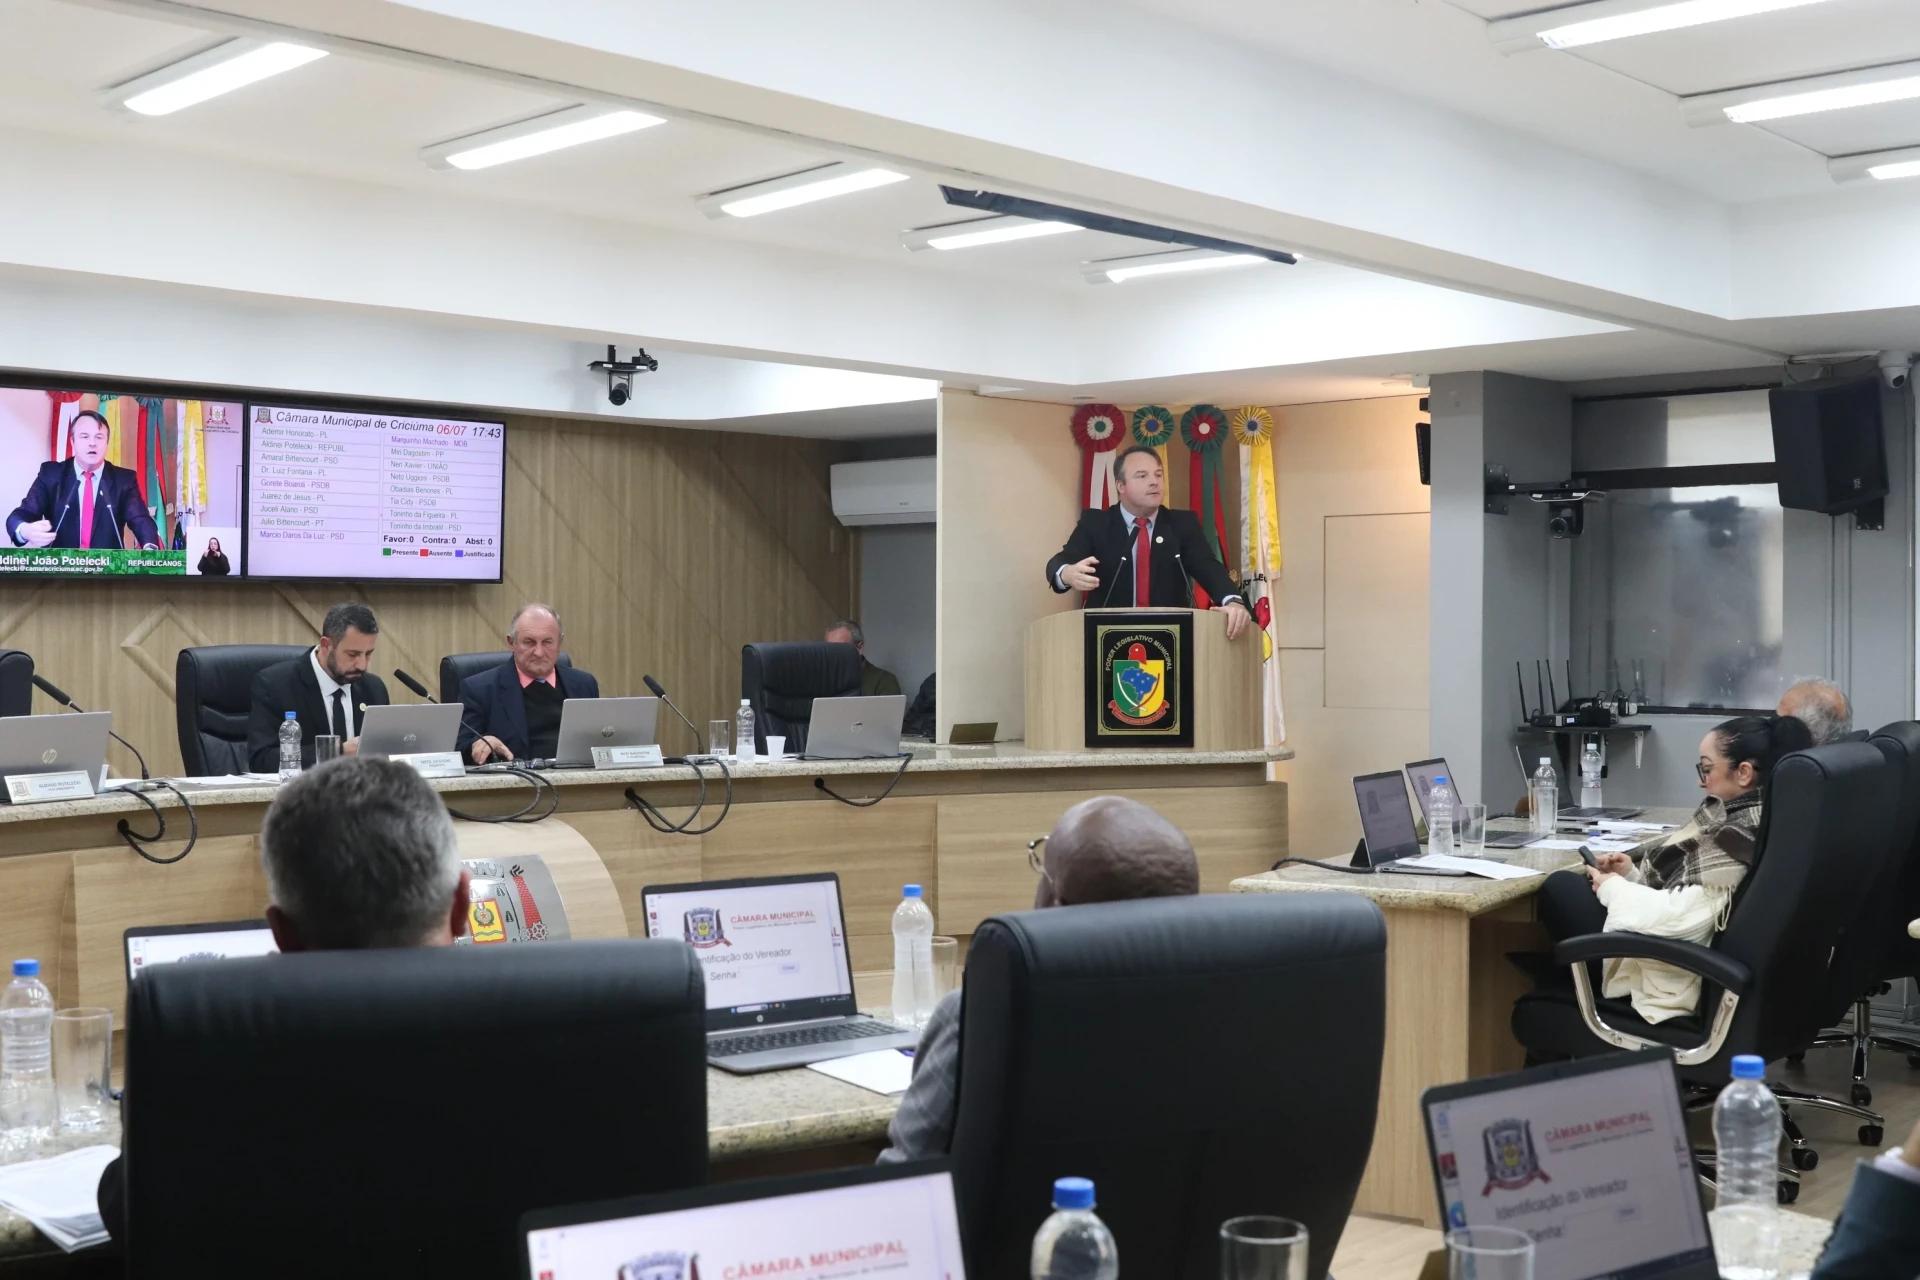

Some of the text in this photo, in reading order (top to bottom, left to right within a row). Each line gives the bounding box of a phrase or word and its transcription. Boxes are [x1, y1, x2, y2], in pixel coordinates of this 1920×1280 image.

[276, 411, 434, 432] Câmara Municipal de Criciúma
[319, 430, 328, 439] PL
[436, 424, 501, 439] 06/07 17:43
[422, 437, 449, 447] Machado
[453, 440, 468, 448] MDB
[285, 454, 319, 463] Bittencourt
[318, 468, 327, 477] PL
[311, 481, 330, 489] PSDB
[260, 491, 282, 500] Juarez
[316, 494, 326, 502] PL
[303, 506, 319, 514] PSD
[276, 518, 310, 527] Bittencourt
[315, 519, 325, 527] PT
[330, 532, 345, 540] PSD
[32, 555, 59, 566] João
[61, 556, 110, 566] Potelecki
[127, 559, 182, 567] REPUBLICANOS
[1105, 634, 1173, 672] PODER LEGISLATIVO MUNICIPAL
[769, 909, 816, 920] MUNICIPAL
[701, 948, 792, 964] ntificação do Vereador
[710, 971, 737, 981] Senha
[809, 1239, 907, 1267] MUNICIPAL
